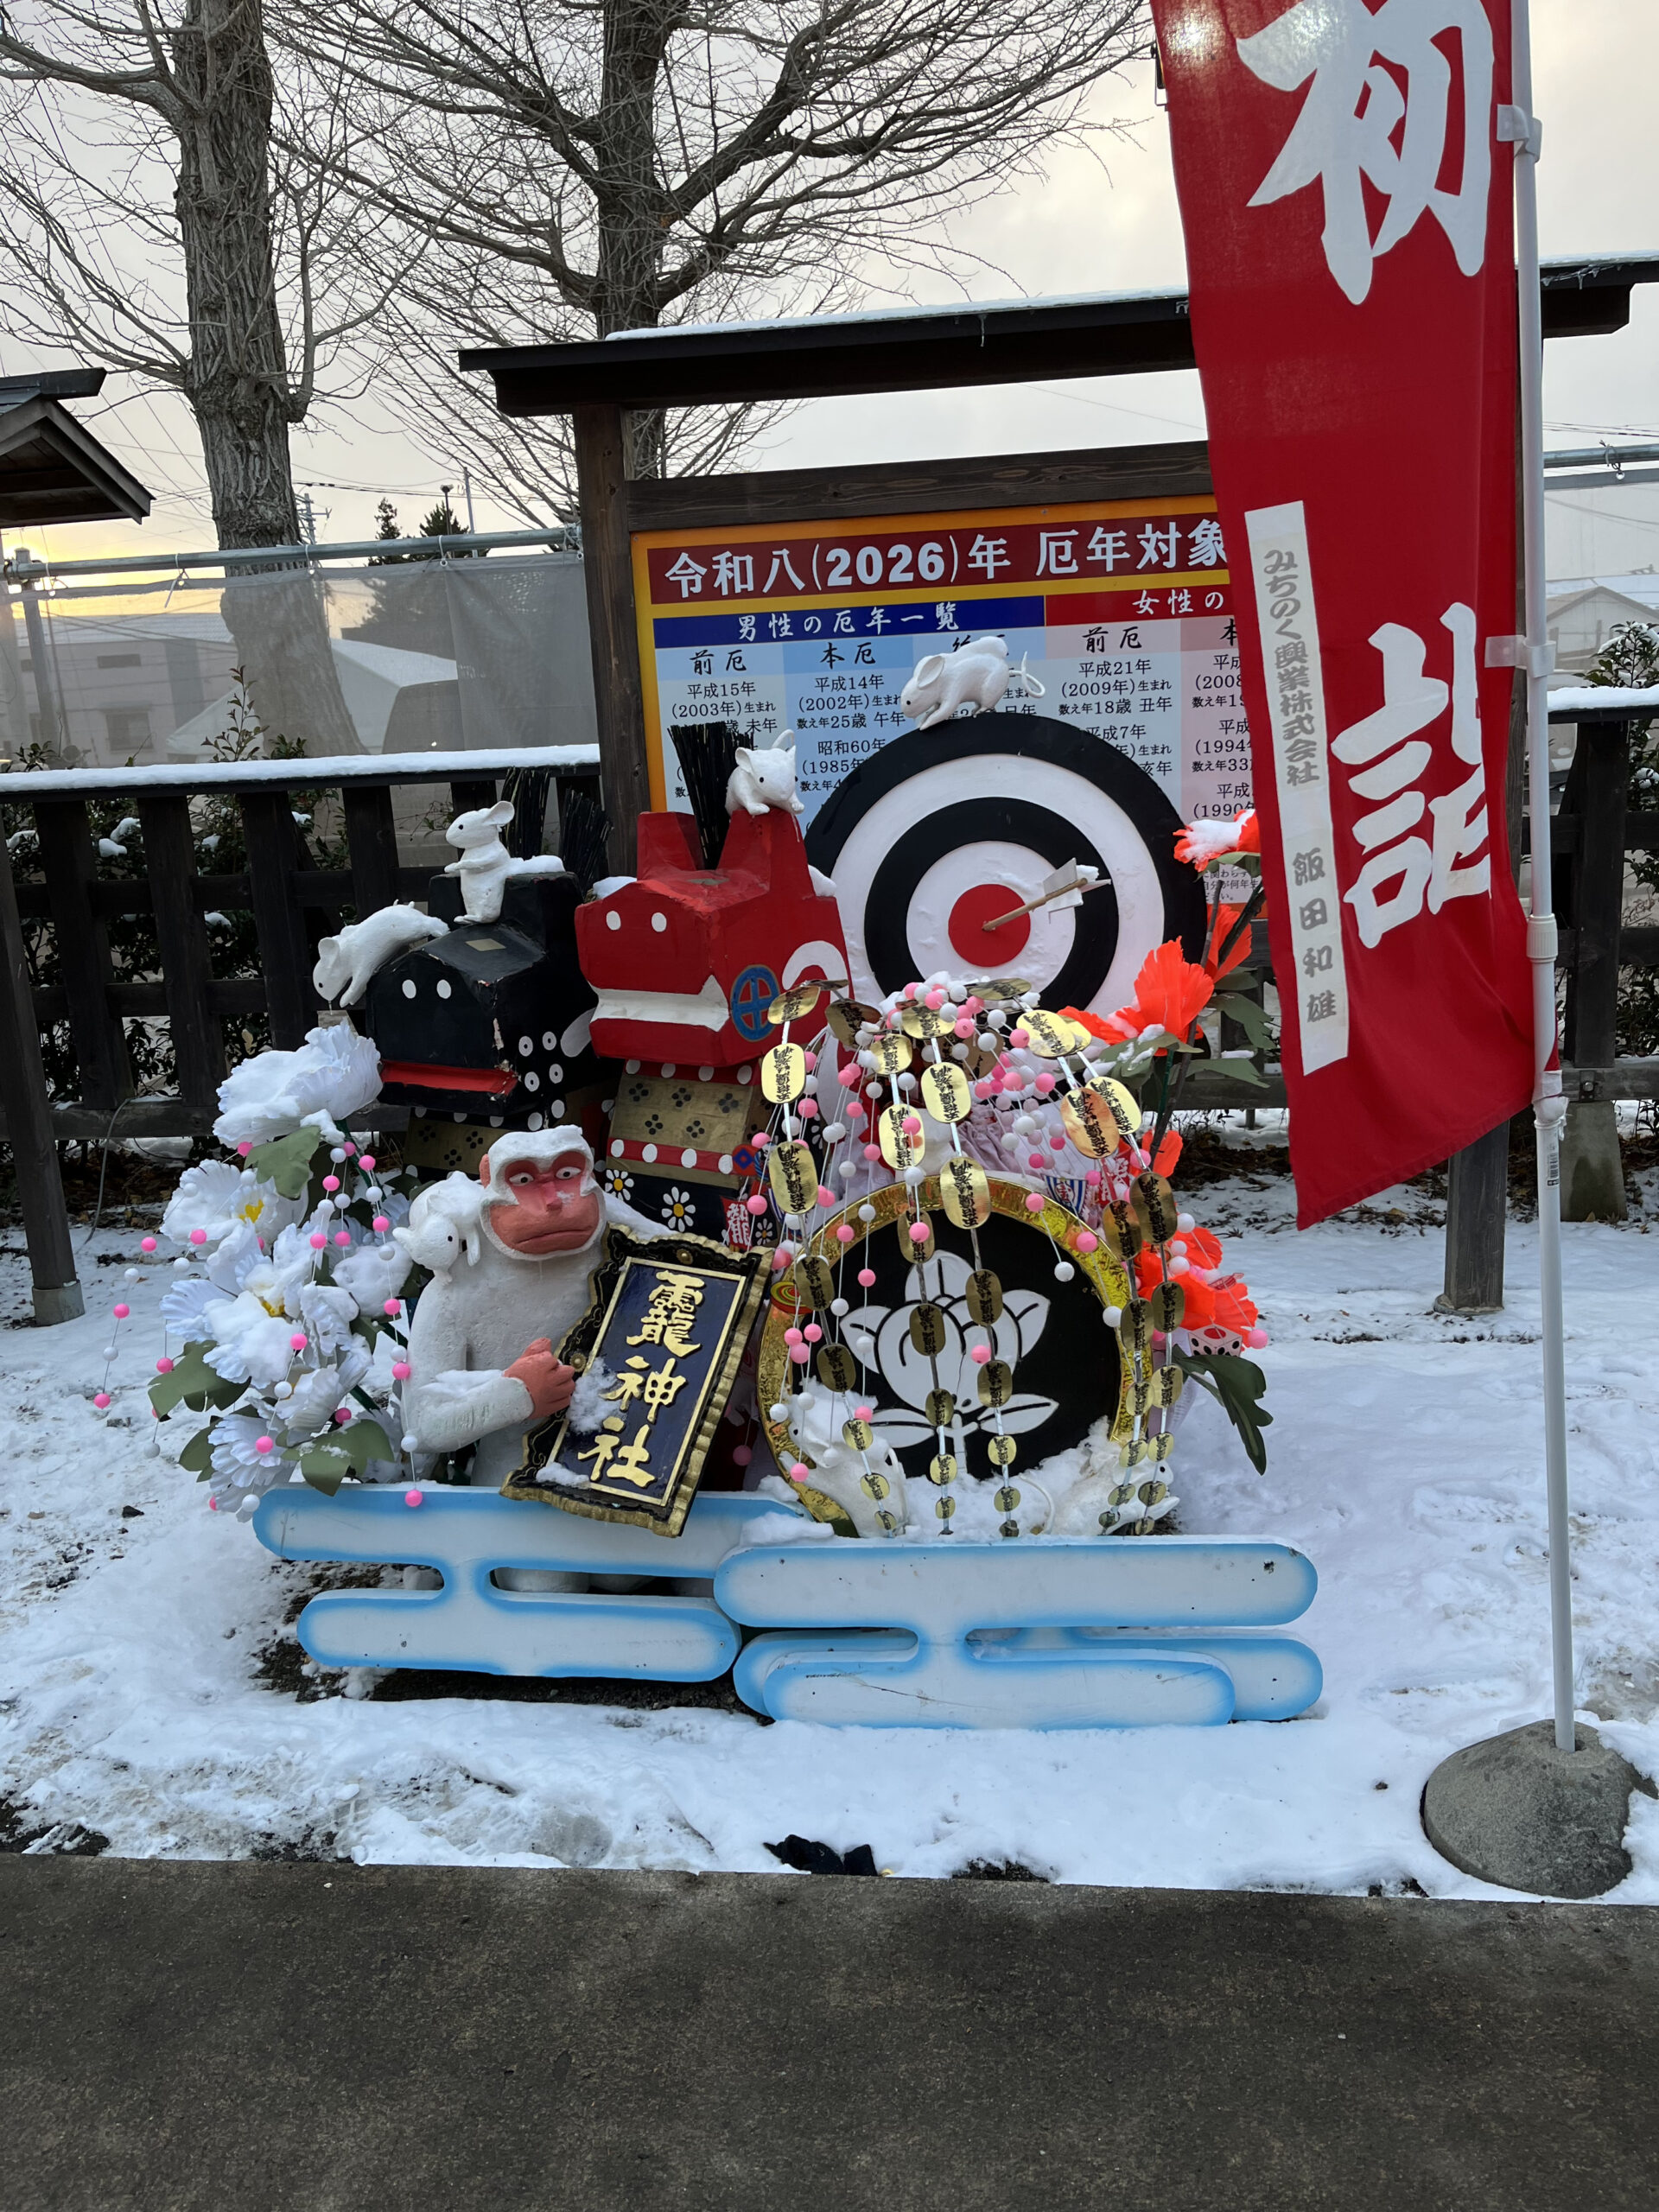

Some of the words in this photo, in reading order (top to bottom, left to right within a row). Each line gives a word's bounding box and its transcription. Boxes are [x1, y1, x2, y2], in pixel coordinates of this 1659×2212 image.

[664, 534, 1011, 599] 令和八(2026)年
[1035, 518, 1228, 576] 厄年対象
[1132, 588, 1224, 615] 女性の
[737, 601, 959, 642] 男性の厄年一覧
[1082, 626, 1142, 653] 前厄
[689, 649, 747, 676] 前厄
[819, 641, 877, 669] 本厄
[1078, 658, 1152, 678] 平成21年
[687, 681, 756, 699] 平成15年
[815, 674, 885, 692] 平成14年
[1061, 678, 1172, 698] (2009年)生まれ
[671, 700, 777, 719] (2003年)生まれ
[1058, 698, 1132, 715] 数え年18歳
[1139, 696, 1173, 713] 丑年
[796, 713, 867, 729] 数え年25歳
[874, 711, 906, 728] 午年
[817, 738, 887, 756] 昭和60年
[1263, 550, 1320, 786] みちのく興業株式会社
[1292, 847, 1338, 1023] 飯田和雄
